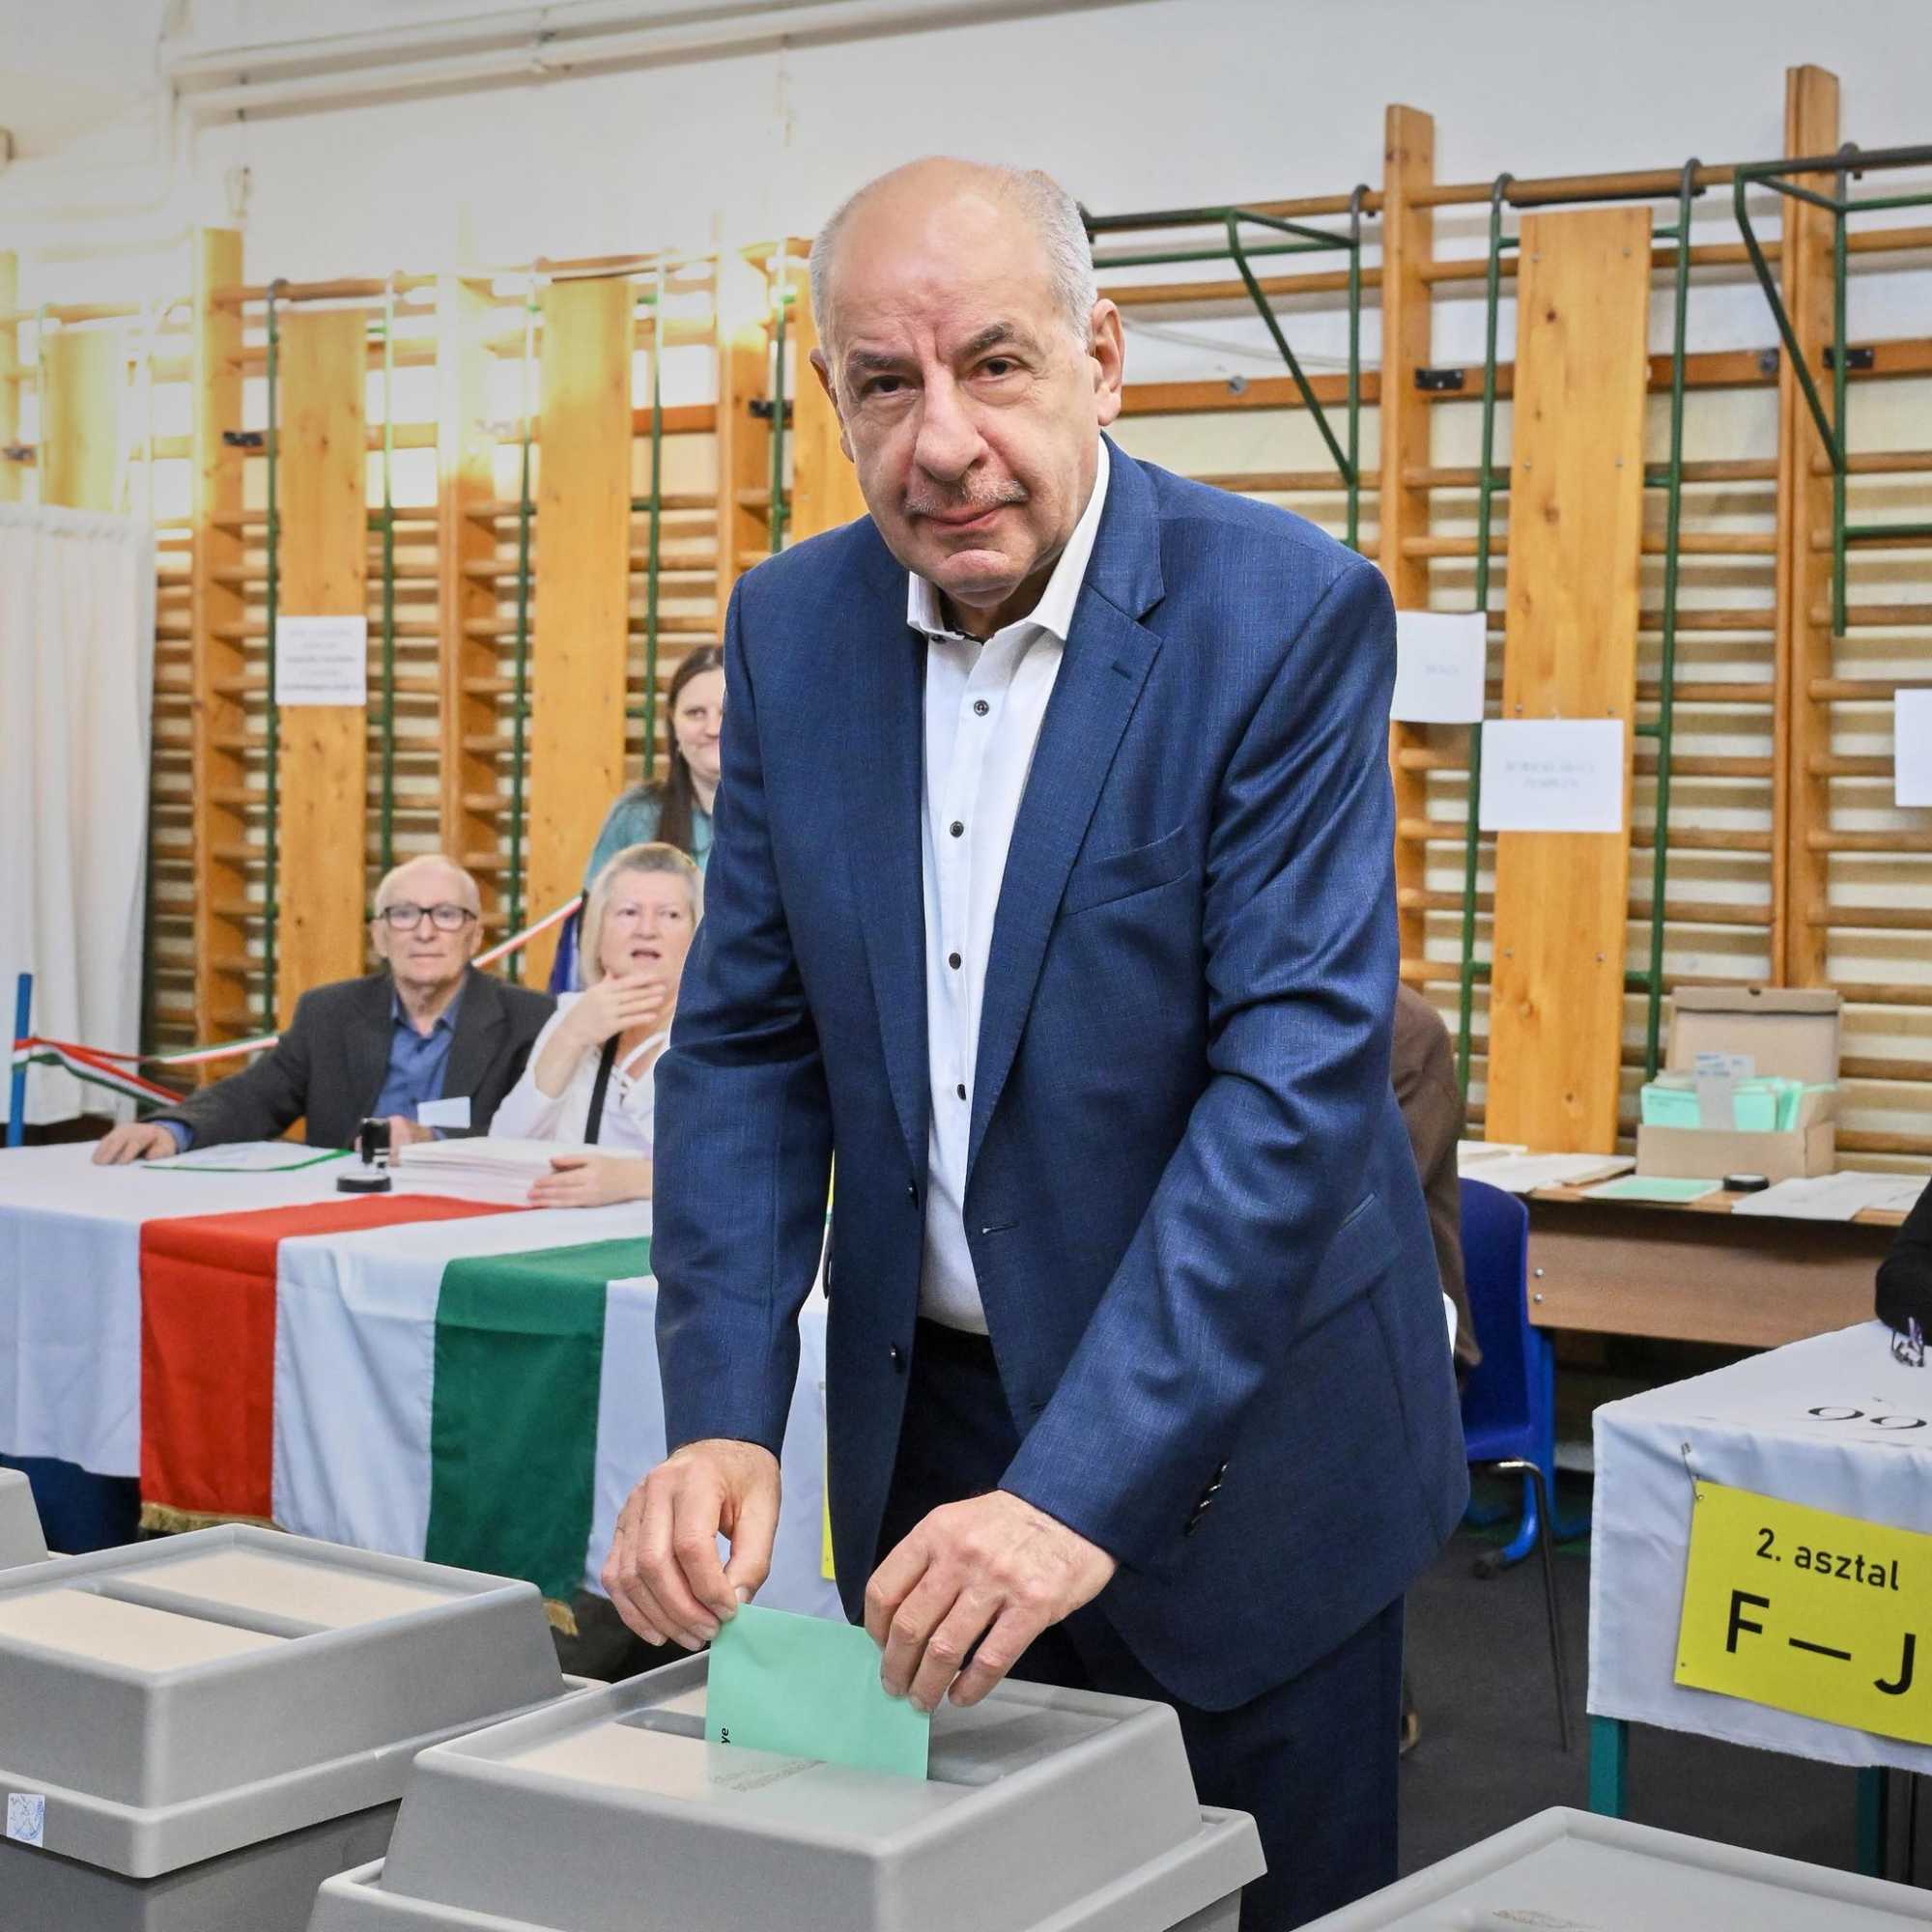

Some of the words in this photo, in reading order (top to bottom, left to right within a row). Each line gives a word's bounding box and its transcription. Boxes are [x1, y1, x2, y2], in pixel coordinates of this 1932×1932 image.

[1756, 1527, 1781, 1562] 2.
[1794, 1546, 1899, 1591] asztal
[1726, 1588, 1770, 1654] F
[1873, 1632, 1917, 1695] J
